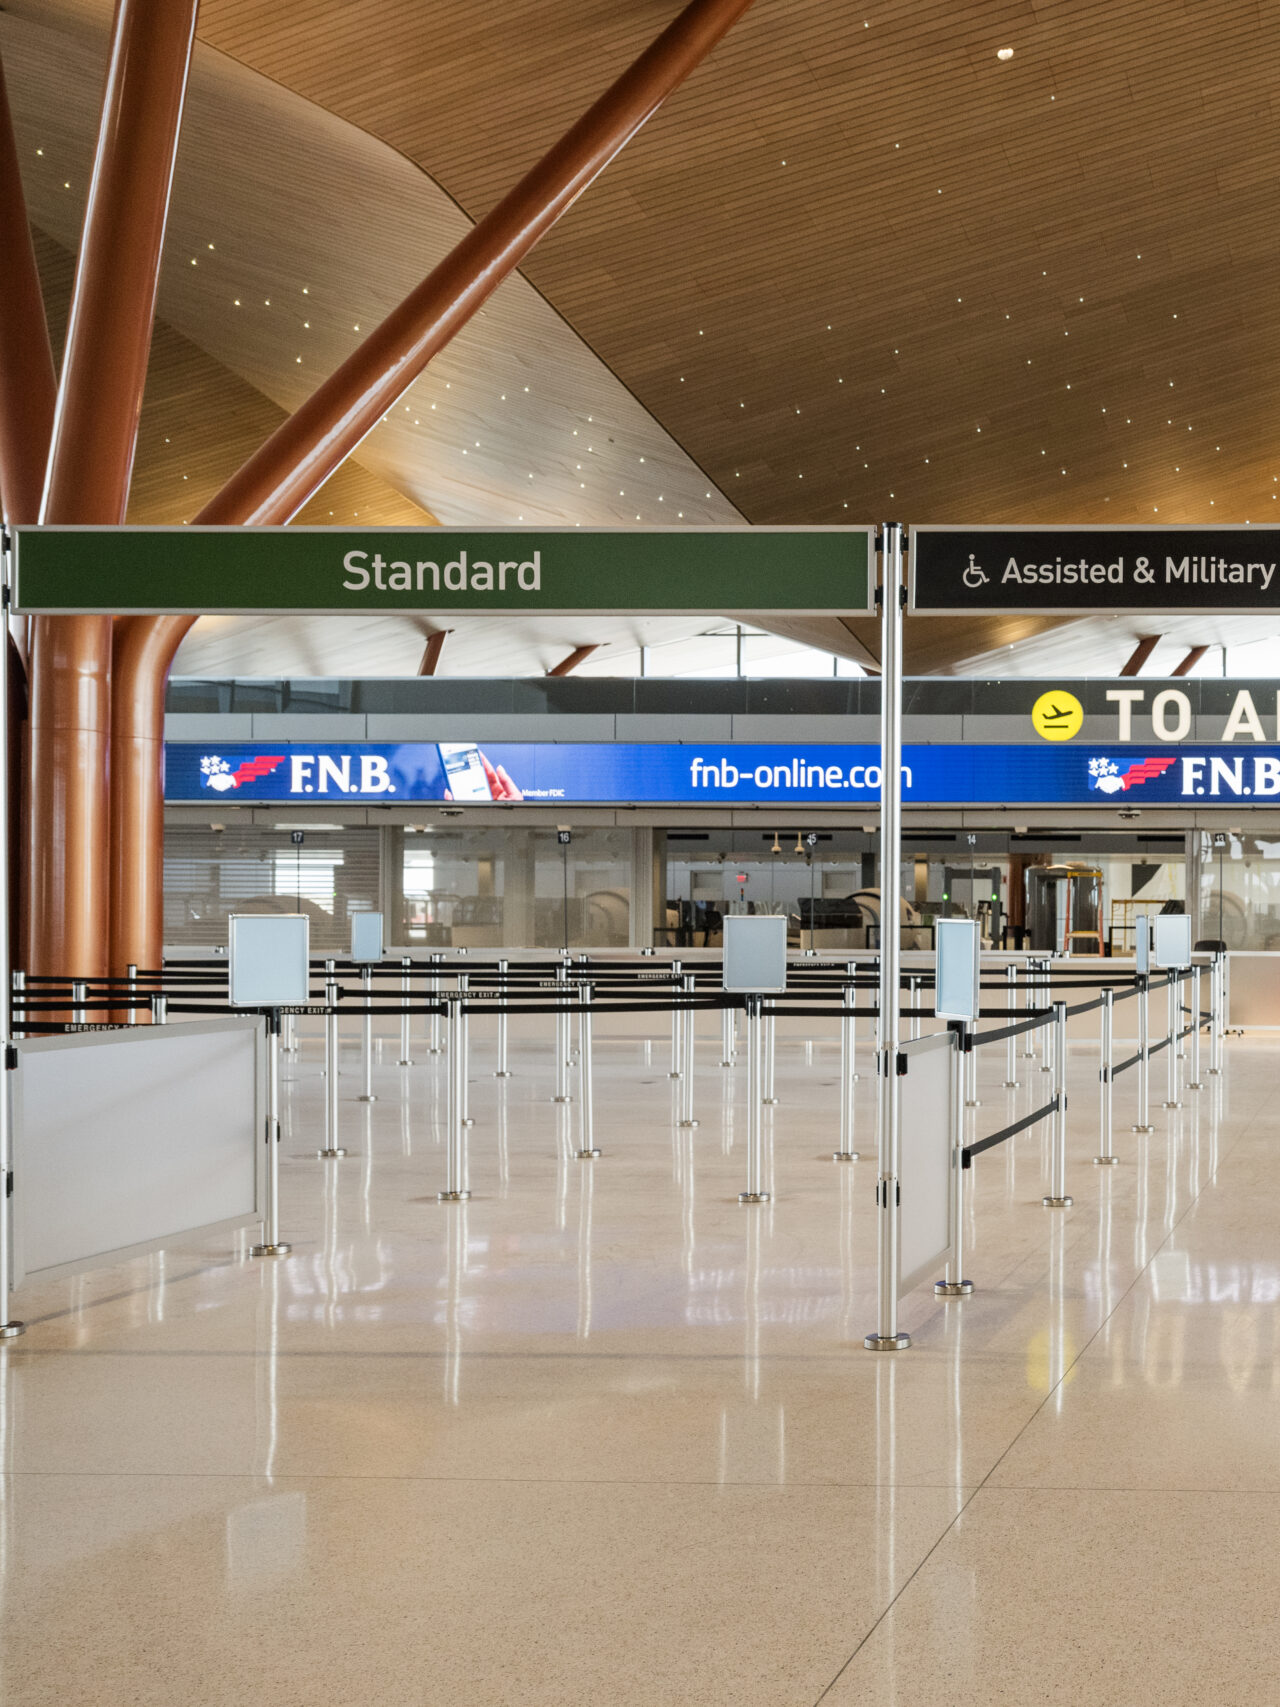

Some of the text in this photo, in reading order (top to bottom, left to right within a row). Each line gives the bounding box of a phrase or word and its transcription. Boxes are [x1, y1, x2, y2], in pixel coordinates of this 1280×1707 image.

[341, 550, 542, 591] Standard
[1001, 556, 1277, 590] Assisted & Military
[1106, 689, 1192, 742] TO
[289, 755, 396, 793] F.N.B.
[293, 832, 302, 841] 17
[560, 832, 570, 842] 16
[967, 834, 976, 845] 14
[307, 1007, 325, 1015] EXIT
[64, 1024, 119, 1032] EMERGENCY
